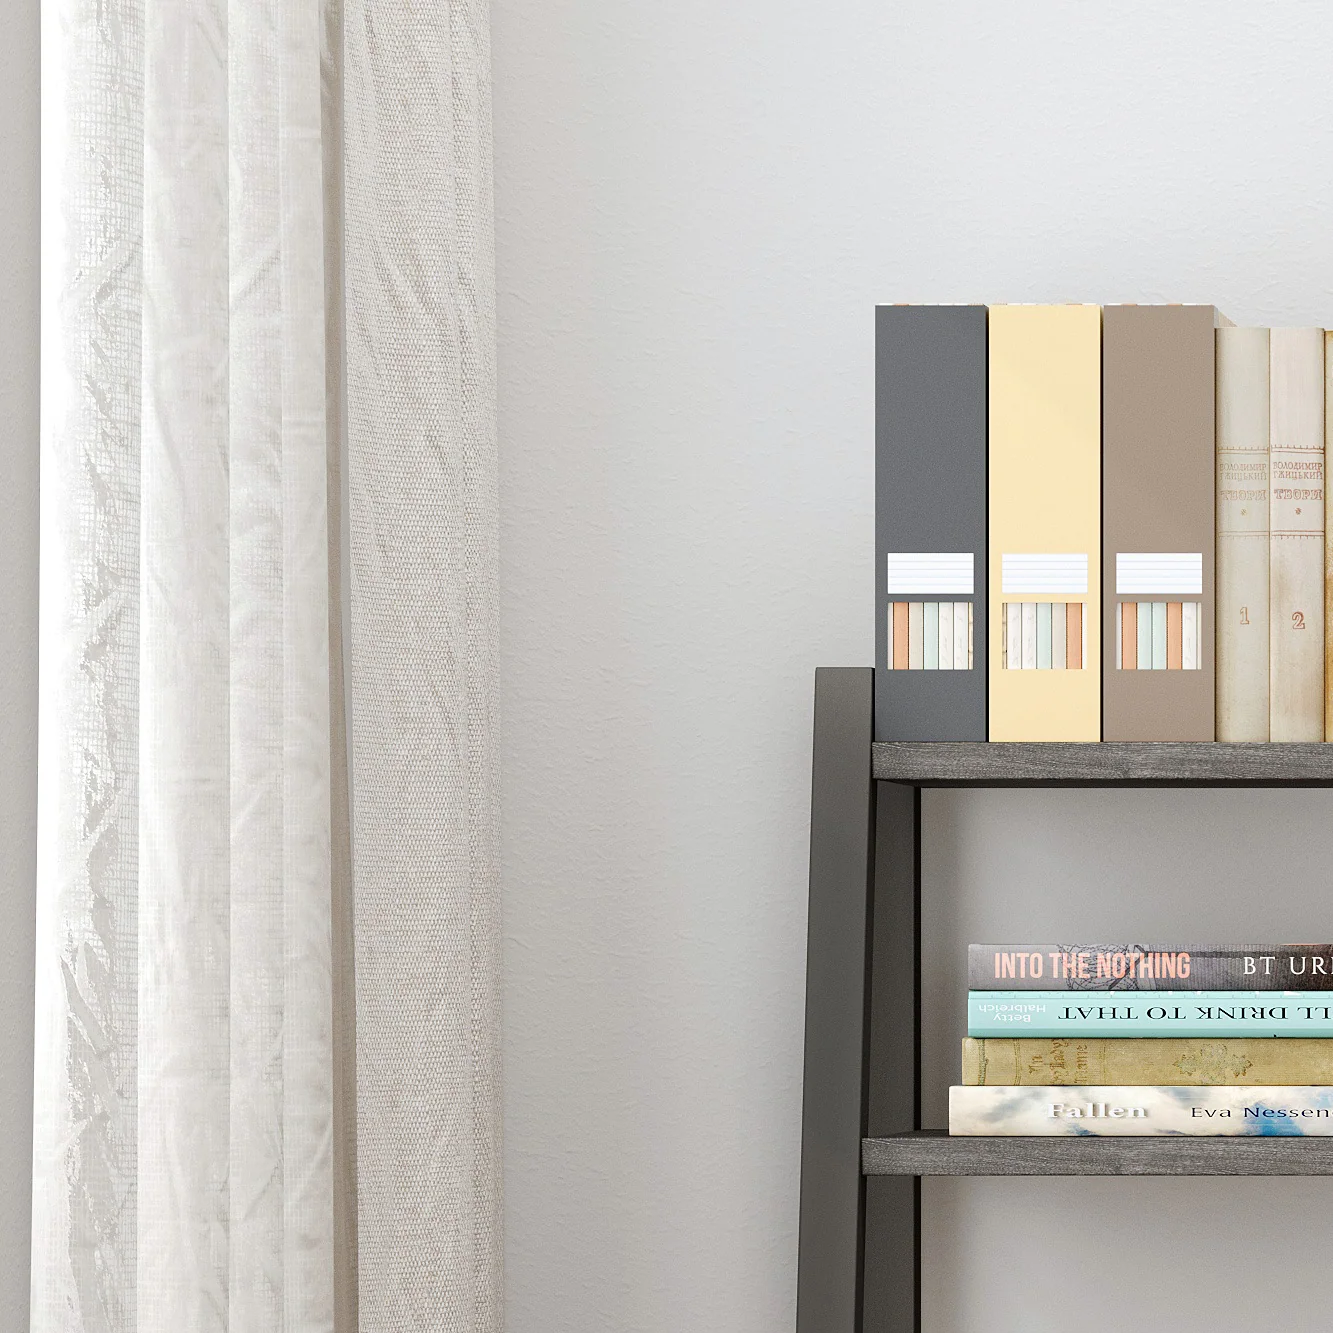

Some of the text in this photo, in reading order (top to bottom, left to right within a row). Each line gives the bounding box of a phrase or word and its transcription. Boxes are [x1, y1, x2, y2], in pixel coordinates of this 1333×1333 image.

[1273, 461, 1323, 472] ВОЛОДИМИР
[1220, 489, 1266, 500] ТВОРИ
[1273, 488, 1323, 500] ТВОРИ
[1239, 607, 1250, 625] 1
[1292, 611, 1305, 629] 2
[994, 952, 1044, 980] INTO
[1047, 952, 1091, 980] THE
[1095, 952, 1191, 980] NOTHING
[1243, 957, 1276, 976] BT
[978, 1004, 1046, 1013] Halbreich
[1057, 1006, 1139, 1020] THAT
[1146, 1006, 1186, 1020] TO
[1199, 1006, 1287, 1020] DRINK
[993, 1013, 1031, 1023] Betty
[1047, 1101, 1147, 1120] Fallen
[1190, 1106, 1232, 1120] Eva
